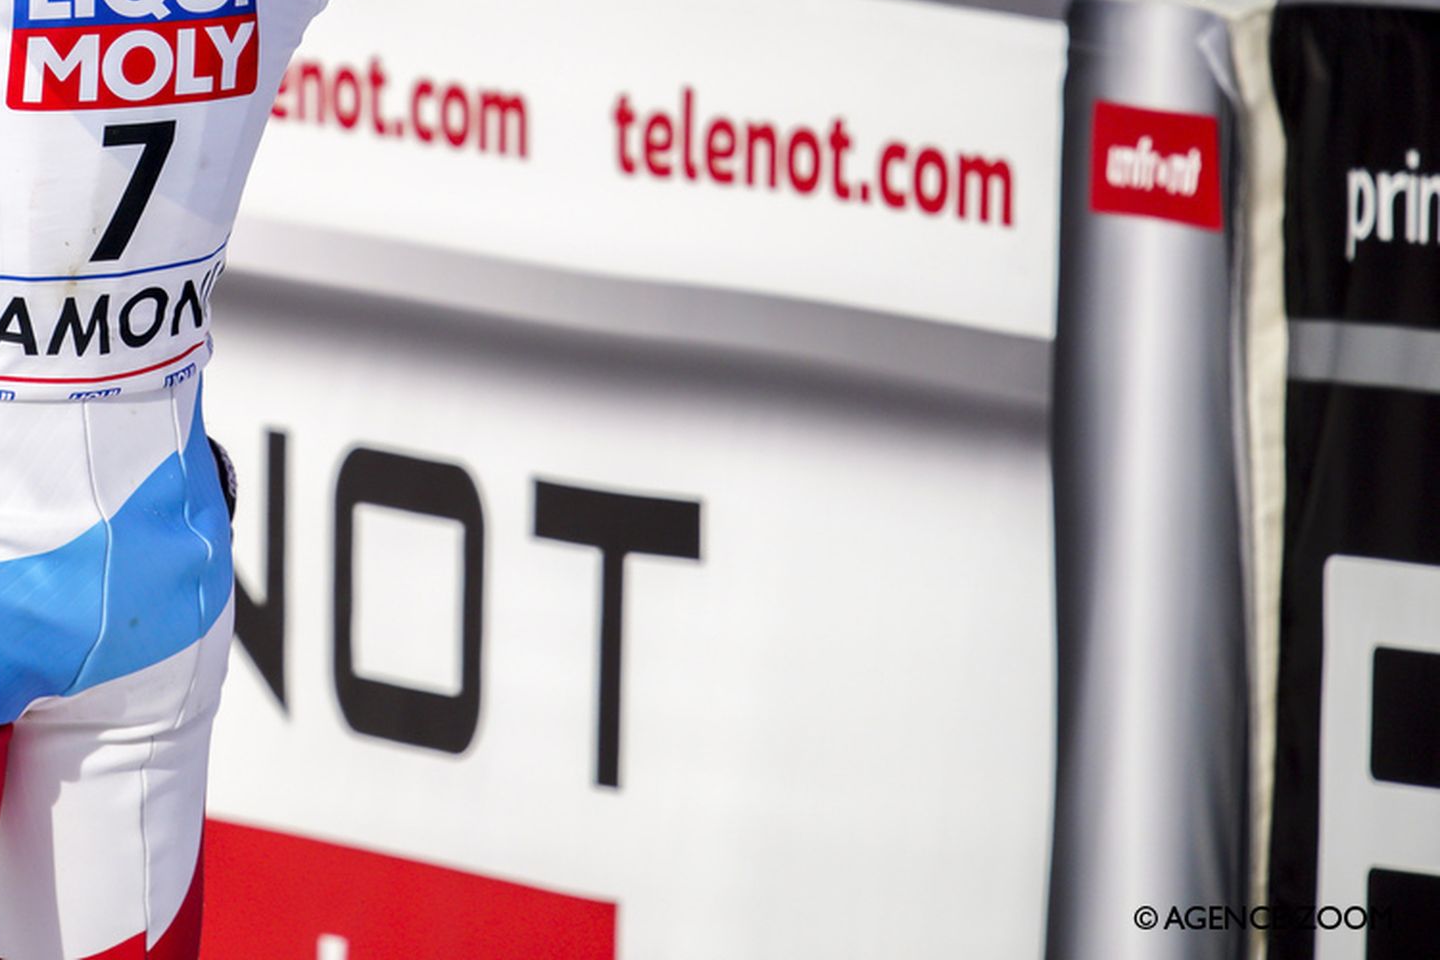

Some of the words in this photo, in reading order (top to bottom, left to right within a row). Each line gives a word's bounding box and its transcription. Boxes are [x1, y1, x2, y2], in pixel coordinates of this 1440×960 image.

[22, 20, 256, 103] MOLY
[89, 119, 177, 263] 7
[613, 86, 1016, 227] telenot.com
